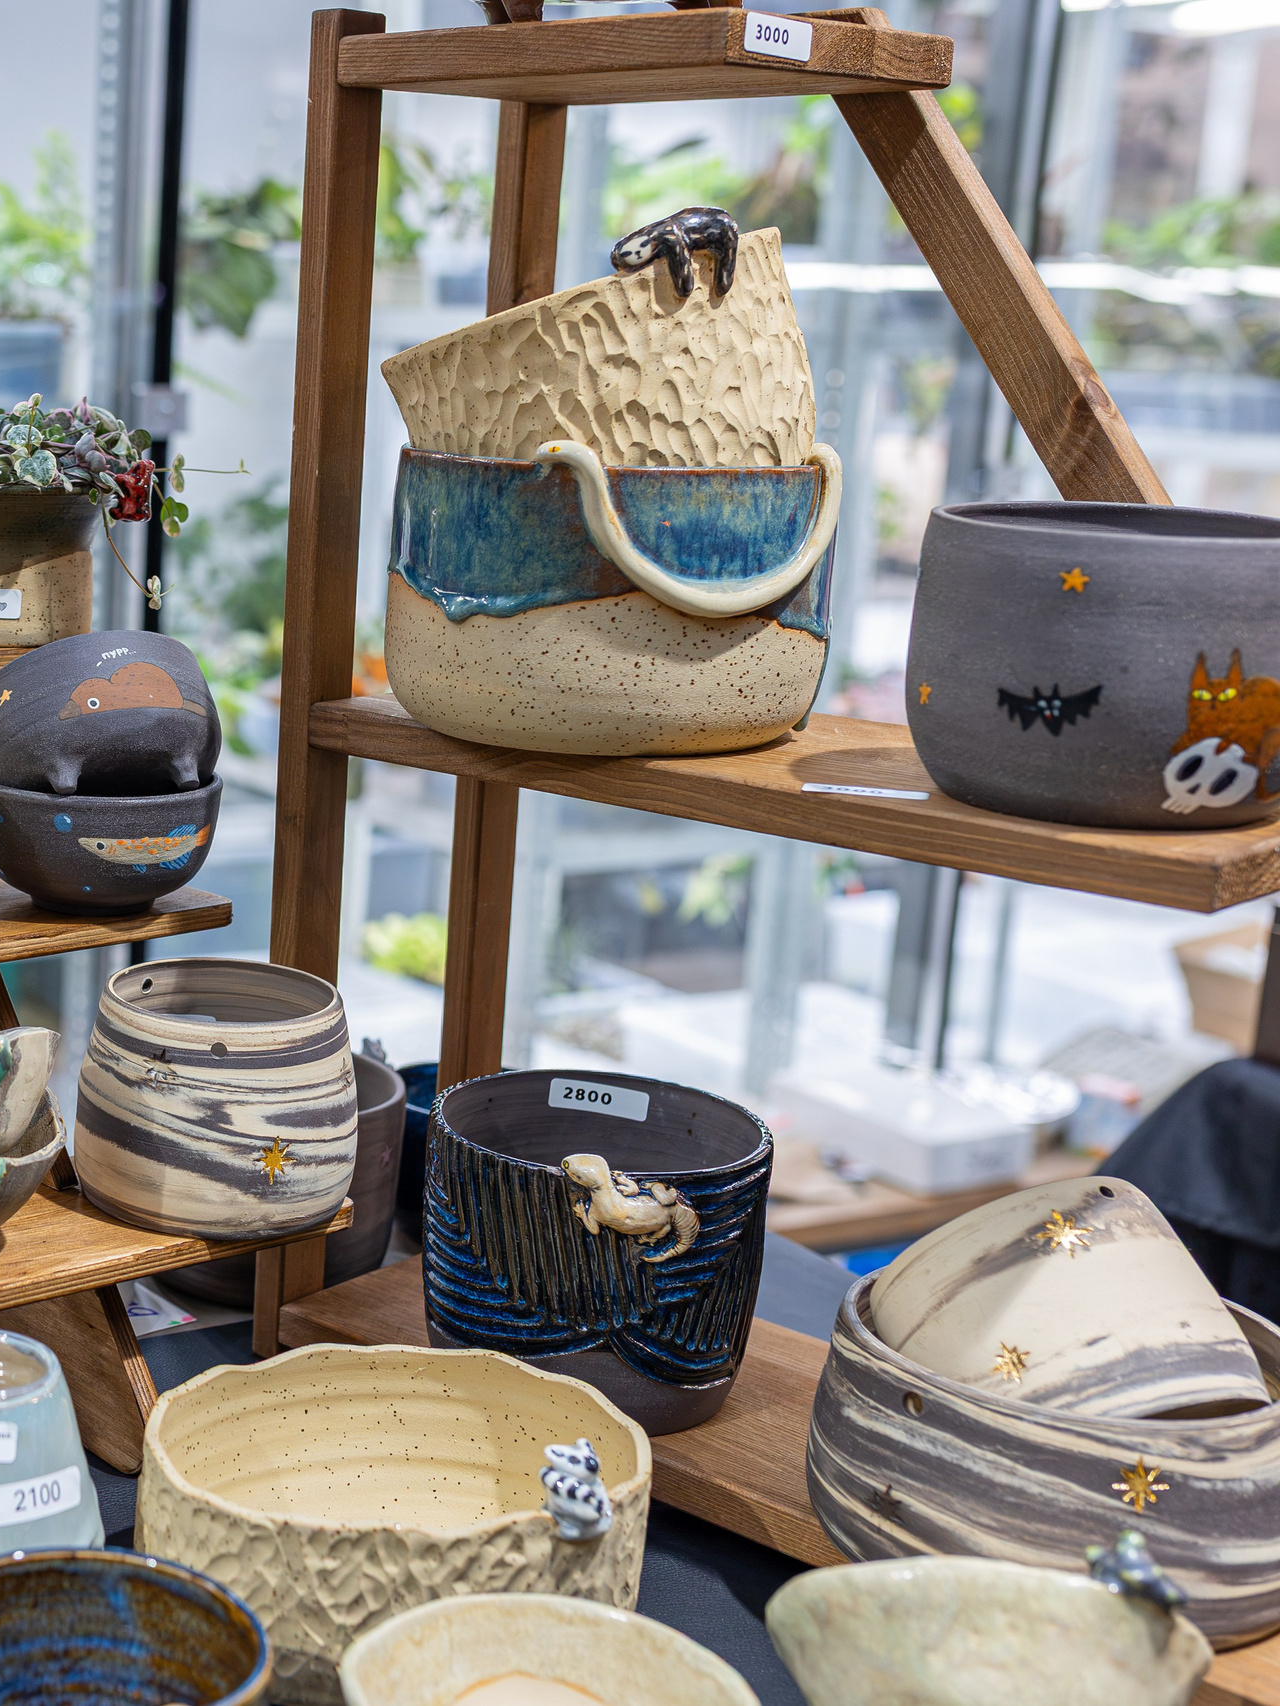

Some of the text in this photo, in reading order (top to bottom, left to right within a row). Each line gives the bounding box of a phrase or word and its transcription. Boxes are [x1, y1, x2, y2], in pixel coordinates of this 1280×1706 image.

[756, 24, 789, 45] 3000
[563, 1087, 612, 1105] 2800
[14, 1480, 61, 1512] 2100
